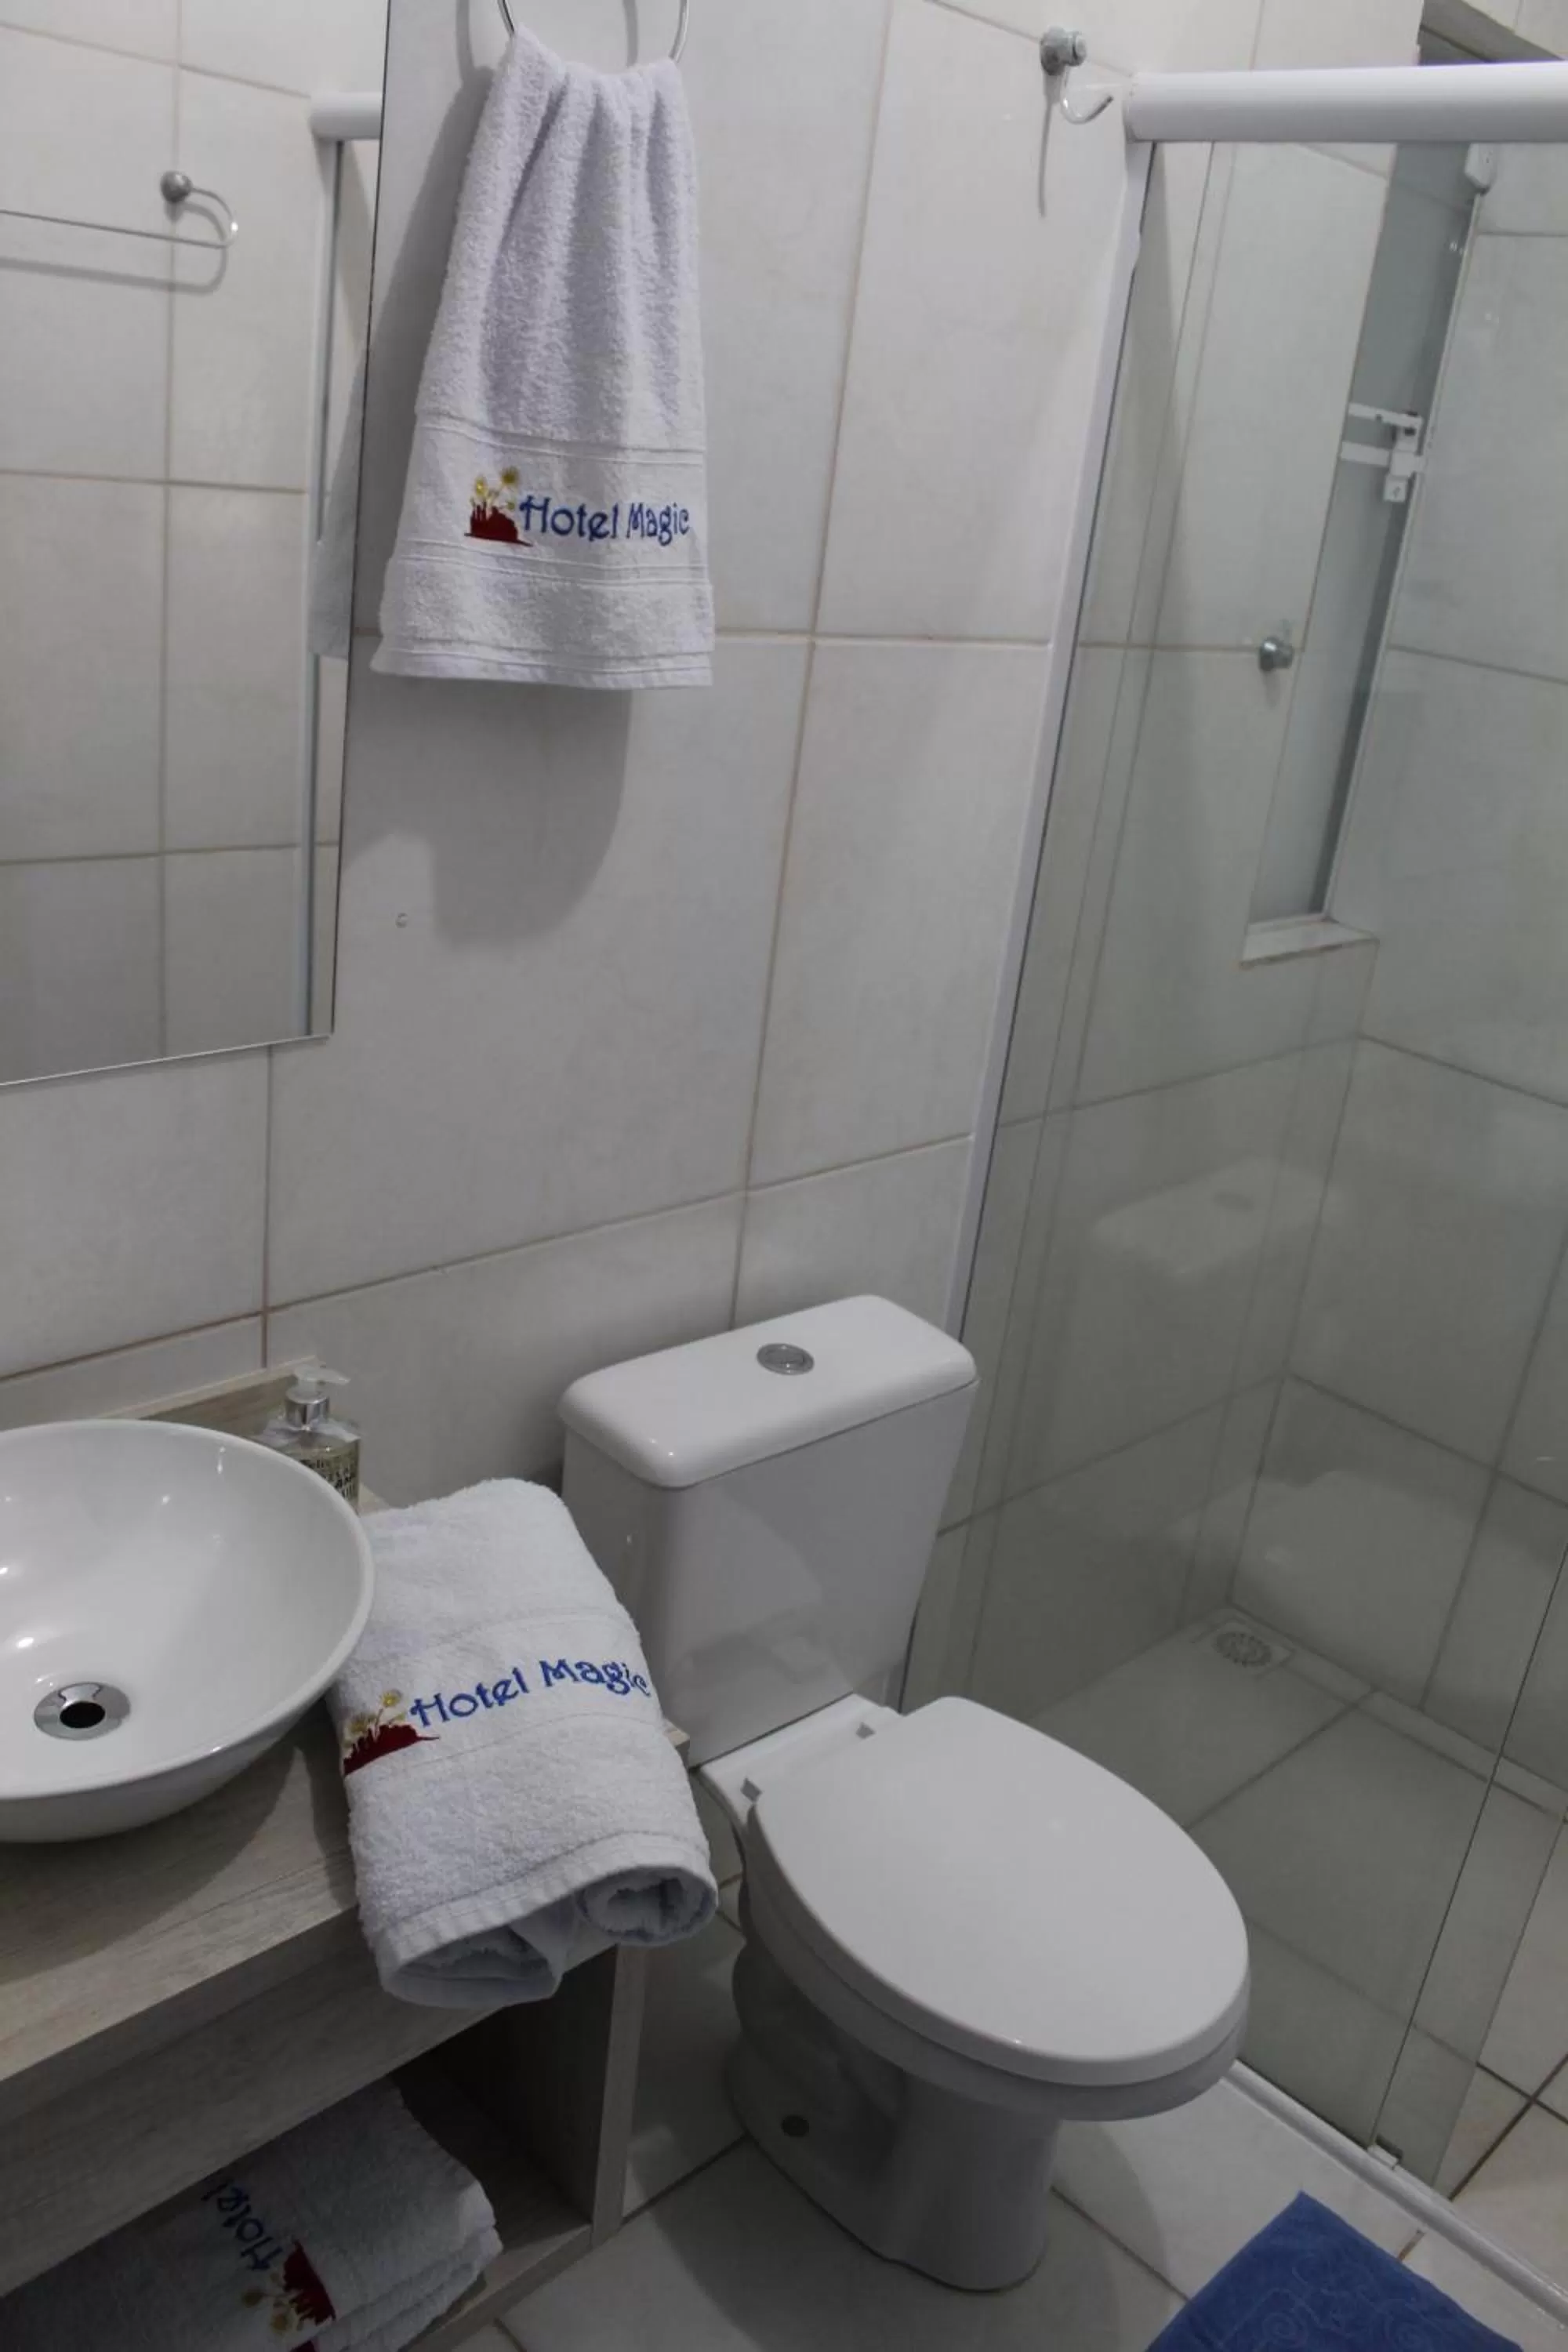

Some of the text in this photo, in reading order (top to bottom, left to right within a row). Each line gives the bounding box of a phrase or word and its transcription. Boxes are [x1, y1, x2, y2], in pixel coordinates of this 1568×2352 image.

[519, 495, 690, 546] Hotel Magic
[409, 1658, 652, 1727] Hotel Magic
[200, 2180, 283, 2271] Hotel
